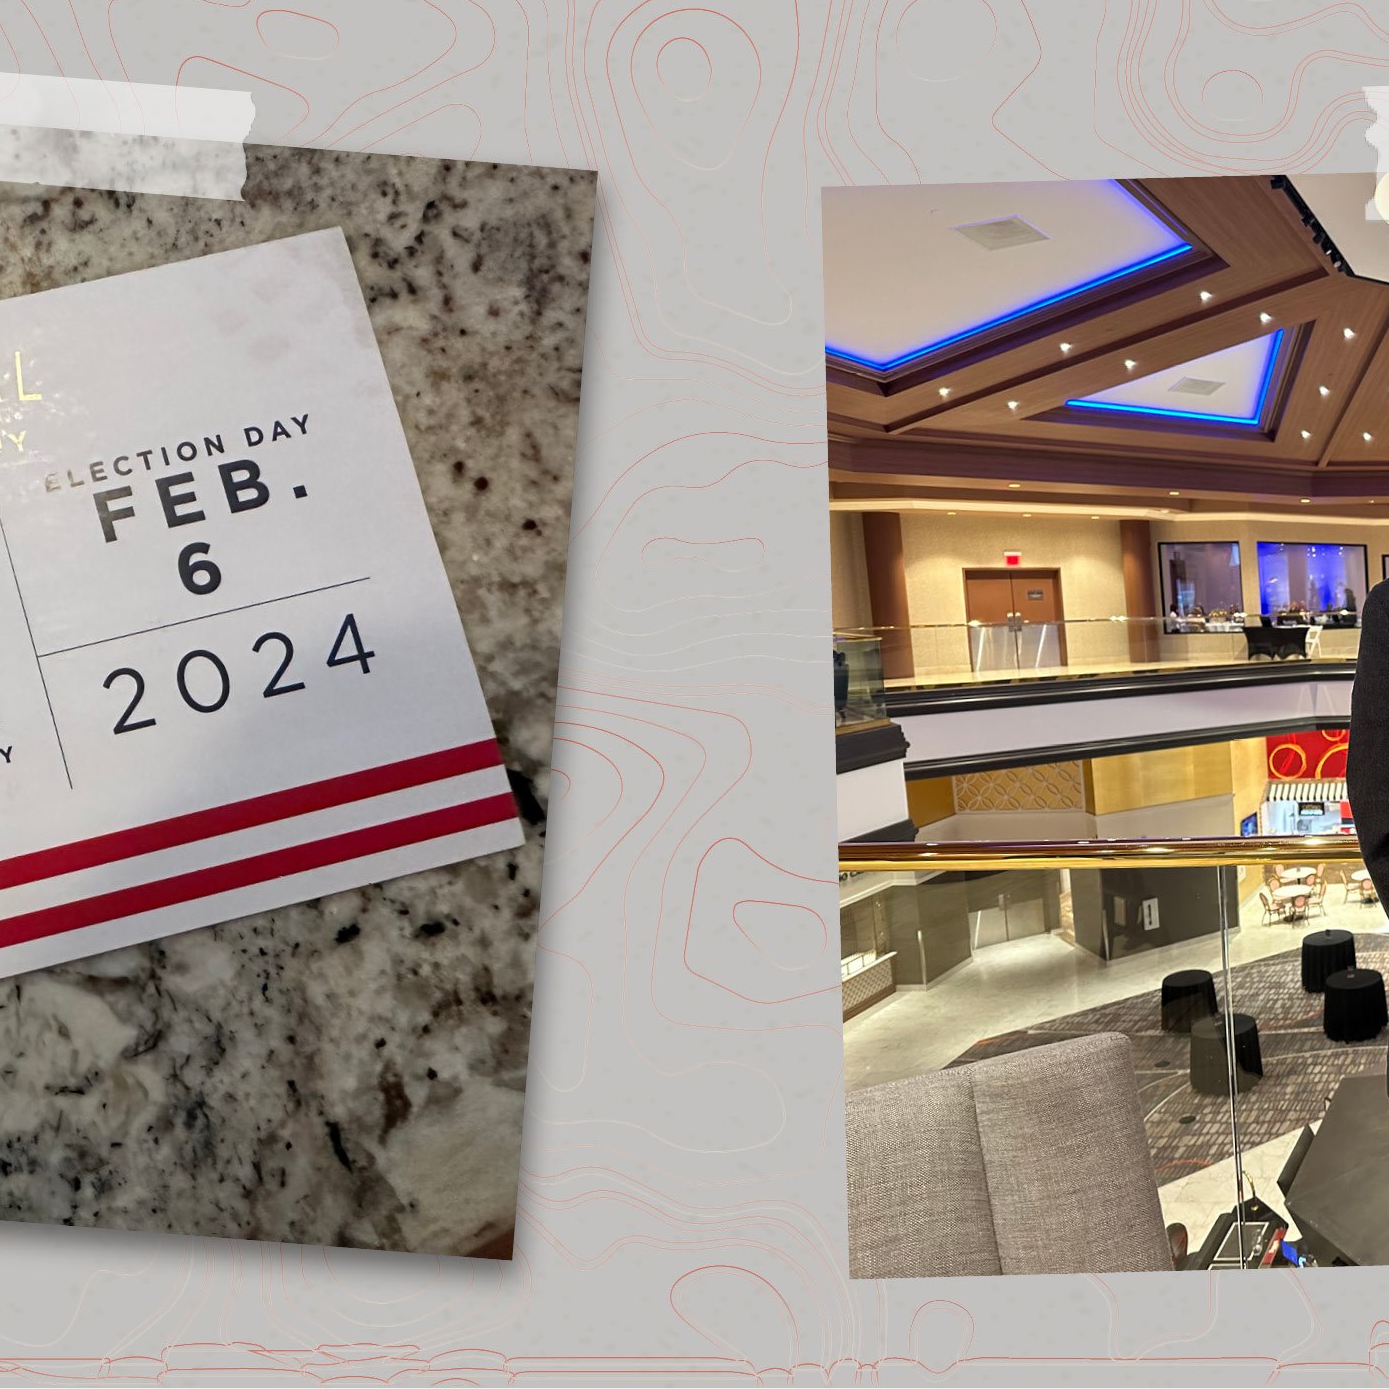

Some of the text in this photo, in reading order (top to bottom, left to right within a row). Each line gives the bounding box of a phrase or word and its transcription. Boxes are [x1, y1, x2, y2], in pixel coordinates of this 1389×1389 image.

[44, 414, 309, 493] ELECTION DAY
[93, 459, 308, 543] FEB.
[177, 541, 222, 596] 6
[103, 613, 376, 735] 2024
